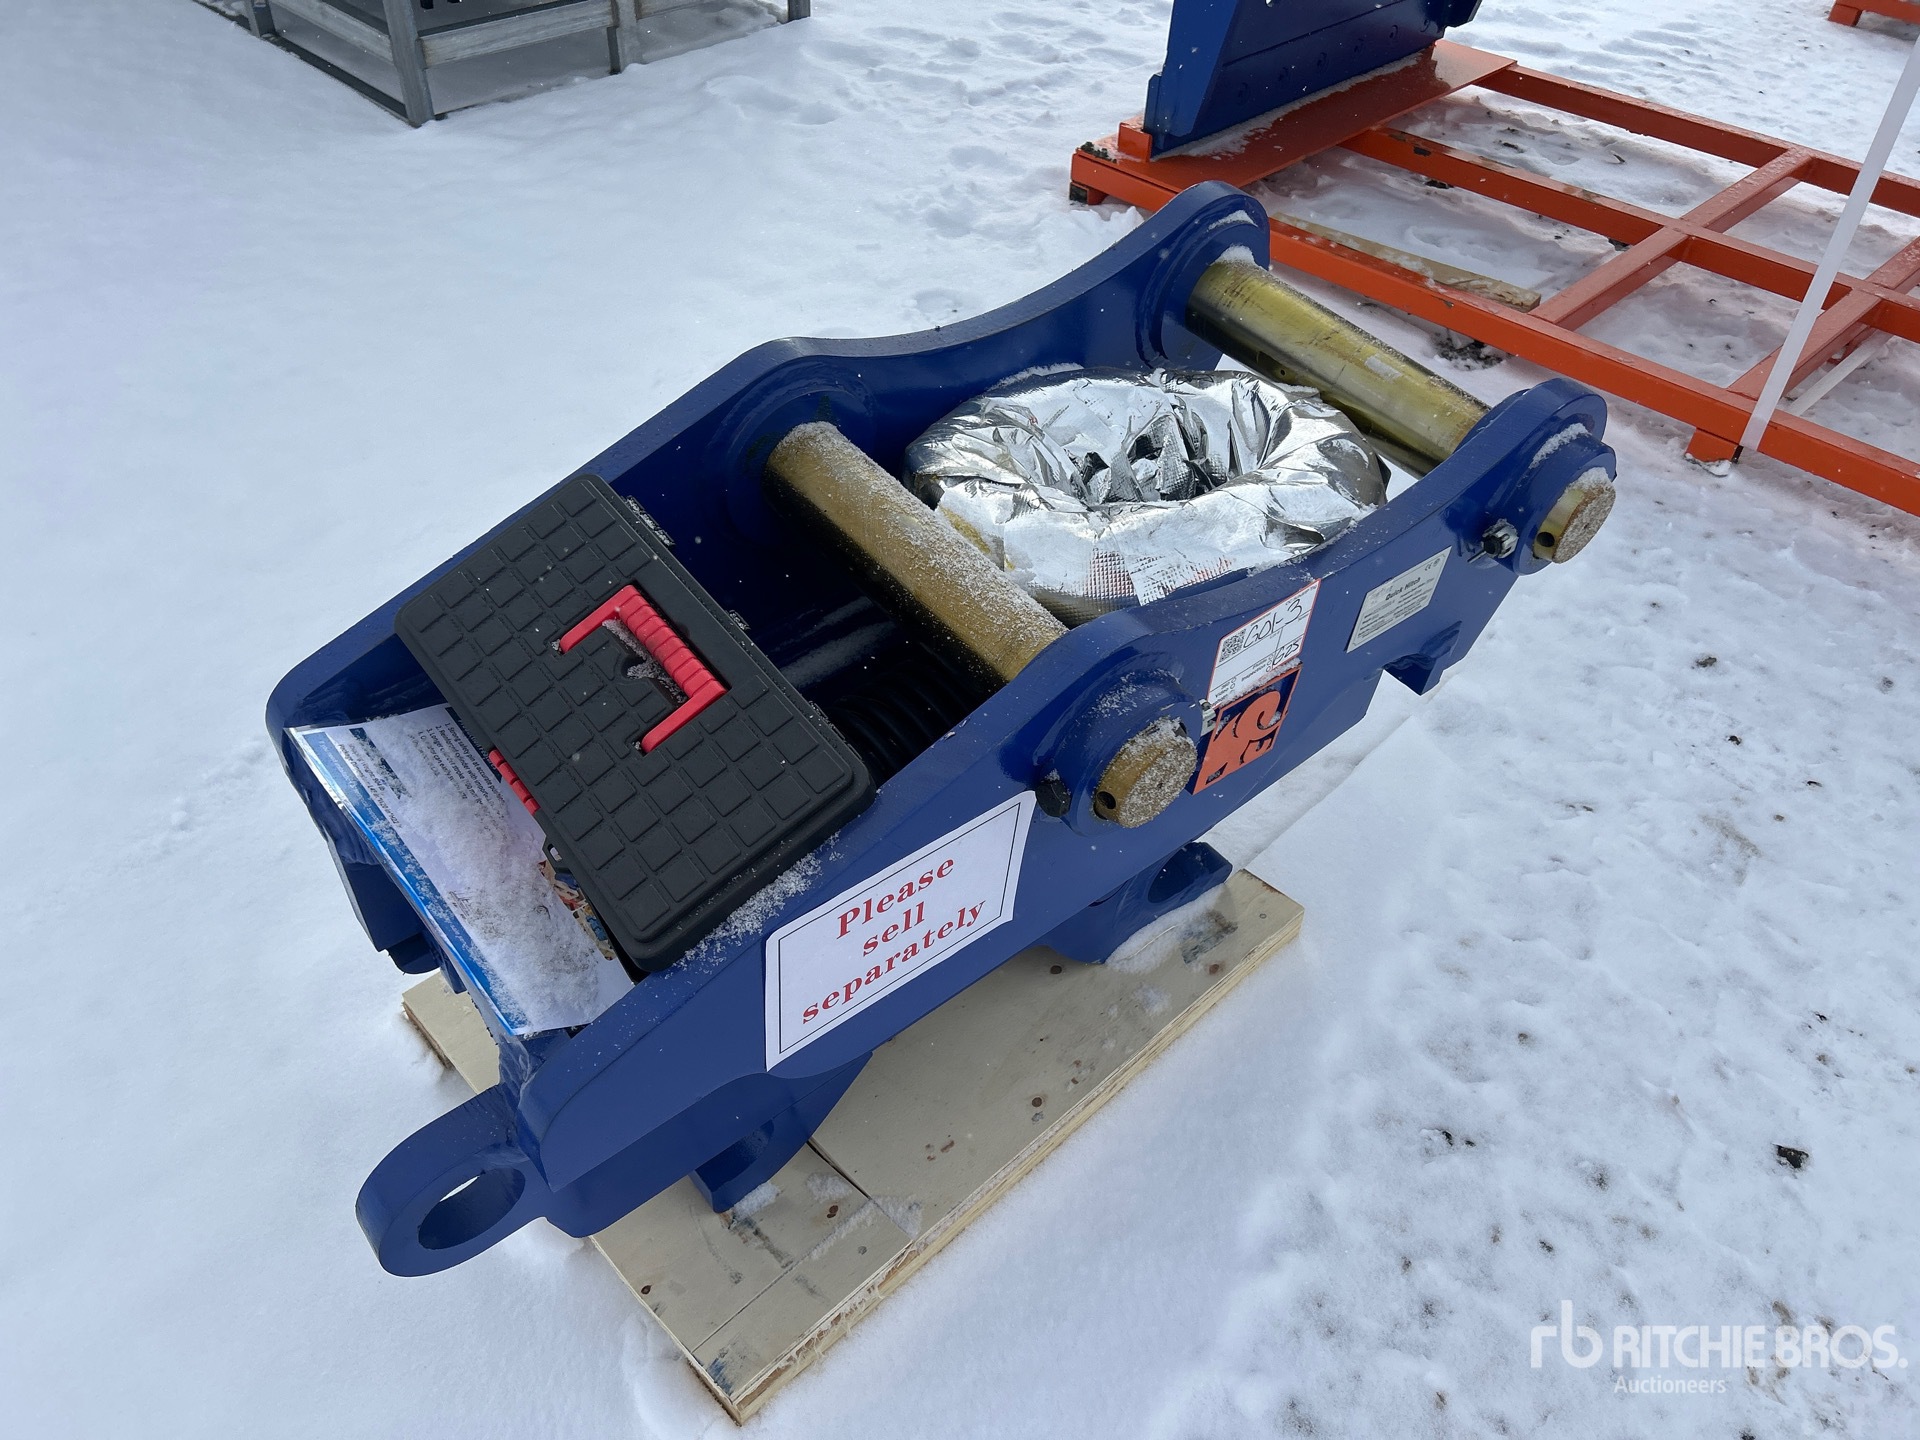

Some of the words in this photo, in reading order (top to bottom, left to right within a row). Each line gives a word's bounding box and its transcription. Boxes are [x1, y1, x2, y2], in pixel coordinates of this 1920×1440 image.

[446, 726, 461, 742] Strong
[456, 739, 471, 754] safety
[836, 858, 955, 940] Please
[862, 901, 926, 957] sell
[802, 900, 986, 1025] separately
